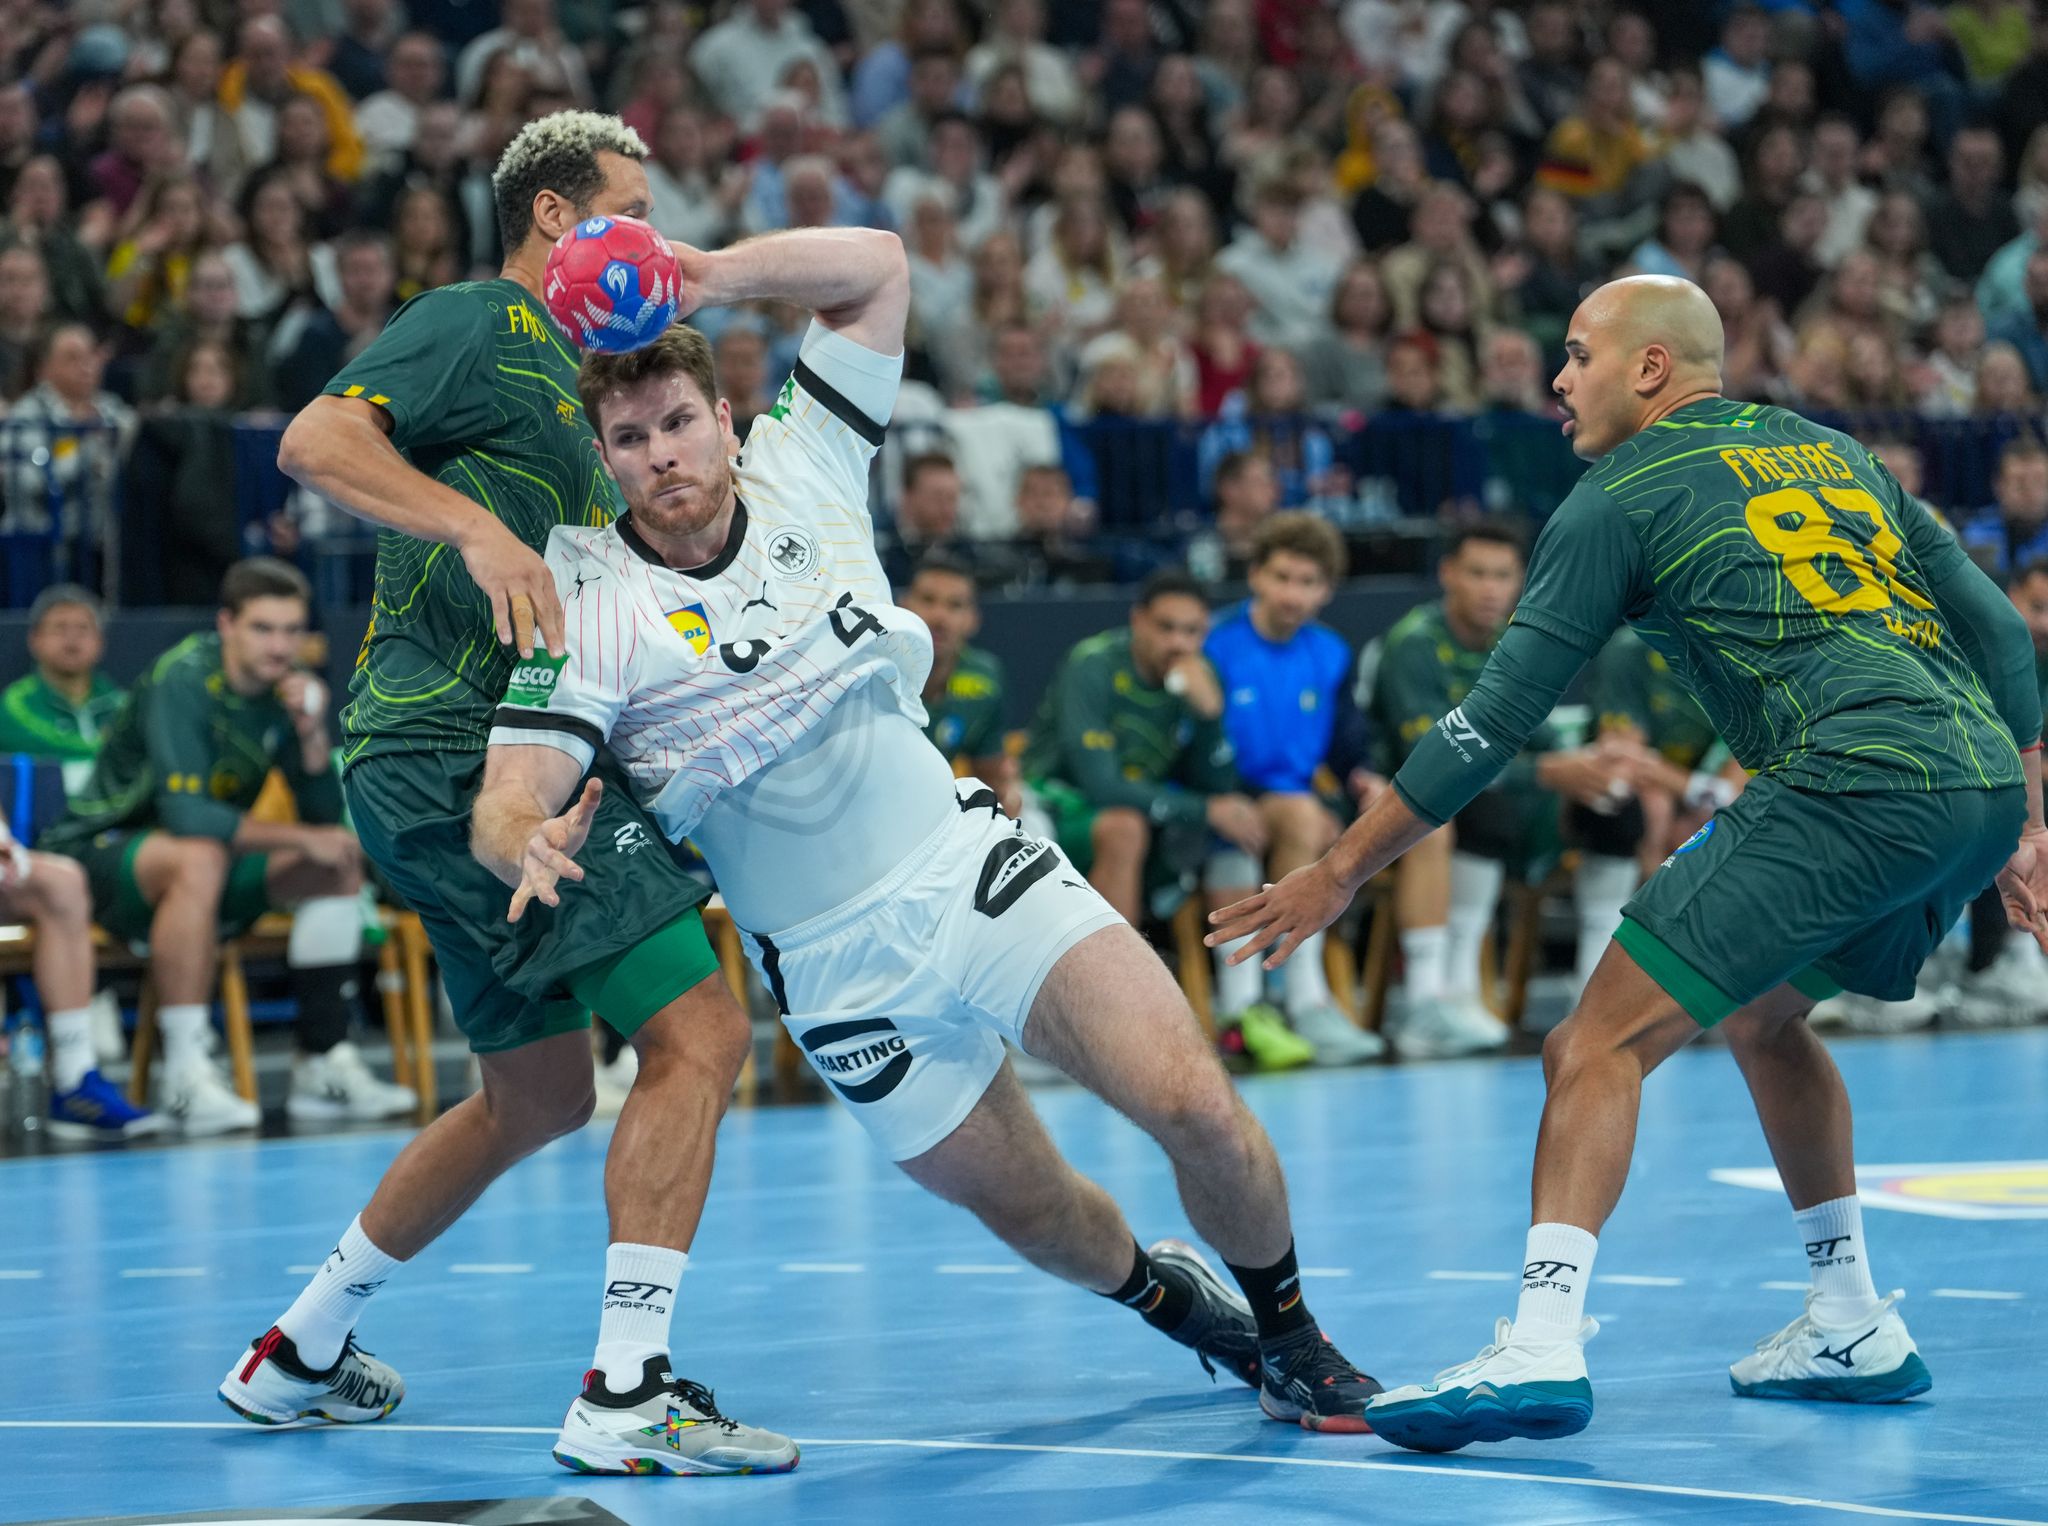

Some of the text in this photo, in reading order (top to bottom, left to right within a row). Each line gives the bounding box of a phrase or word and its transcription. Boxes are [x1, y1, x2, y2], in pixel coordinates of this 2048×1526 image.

[1719, 441, 1854, 488] FREITAS
[814, 1035, 906, 1073] HARTING
[1806, 1234, 1852, 1258] RT
[1523, 1261, 1578, 1279] RT
[1810, 1255, 1856, 1268] PORTS
[605, 1281, 673, 1301] RT
[1521, 1280, 1571, 1294] PORTS
[604, 1300, 666, 1315] SPORTS
